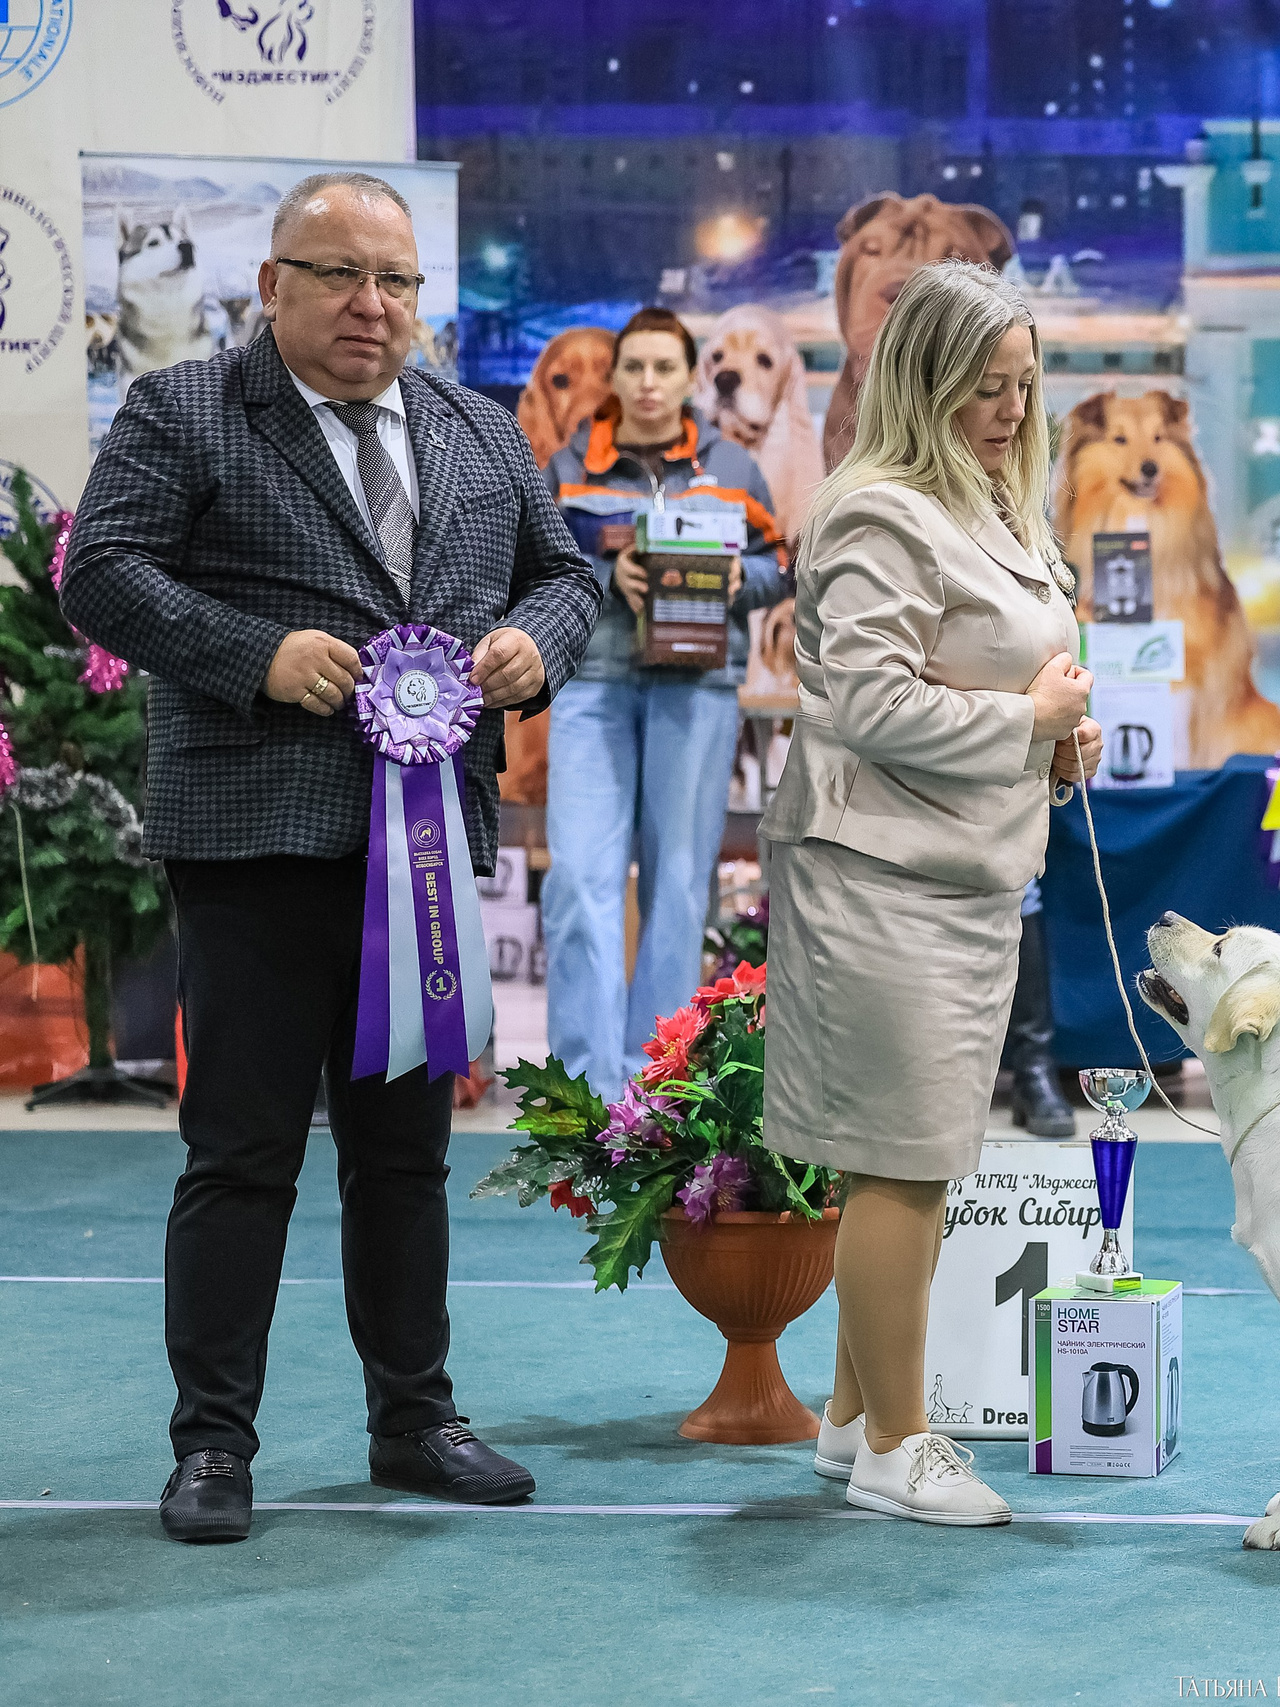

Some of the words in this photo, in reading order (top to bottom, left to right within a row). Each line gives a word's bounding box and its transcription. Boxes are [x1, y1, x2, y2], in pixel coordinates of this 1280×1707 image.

[425, 871, 438, 903] BEST
[428, 904, 440, 919] IN
[430, 920, 444, 965] GROUP
[436, 976, 447, 992] 1
[974, 1173, 1019, 1192] НГКЦ
[995, 1241, 1048, 1376] 1
[1036, 1303, 1051, 1311] 1500
[1057, 1307, 1100, 1320] HOME
[1057, 1320, 1100, 1334] STAR
[1057, 1339, 1086, 1348] ЧАЙНИК
[1087, 1340, 1146, 1350] ЭЛЕКТРИЧЕСКИЙ
[1057, 1347, 1089, 1355] HS-1010A
[983, 1408, 1029, 1425] Drea
